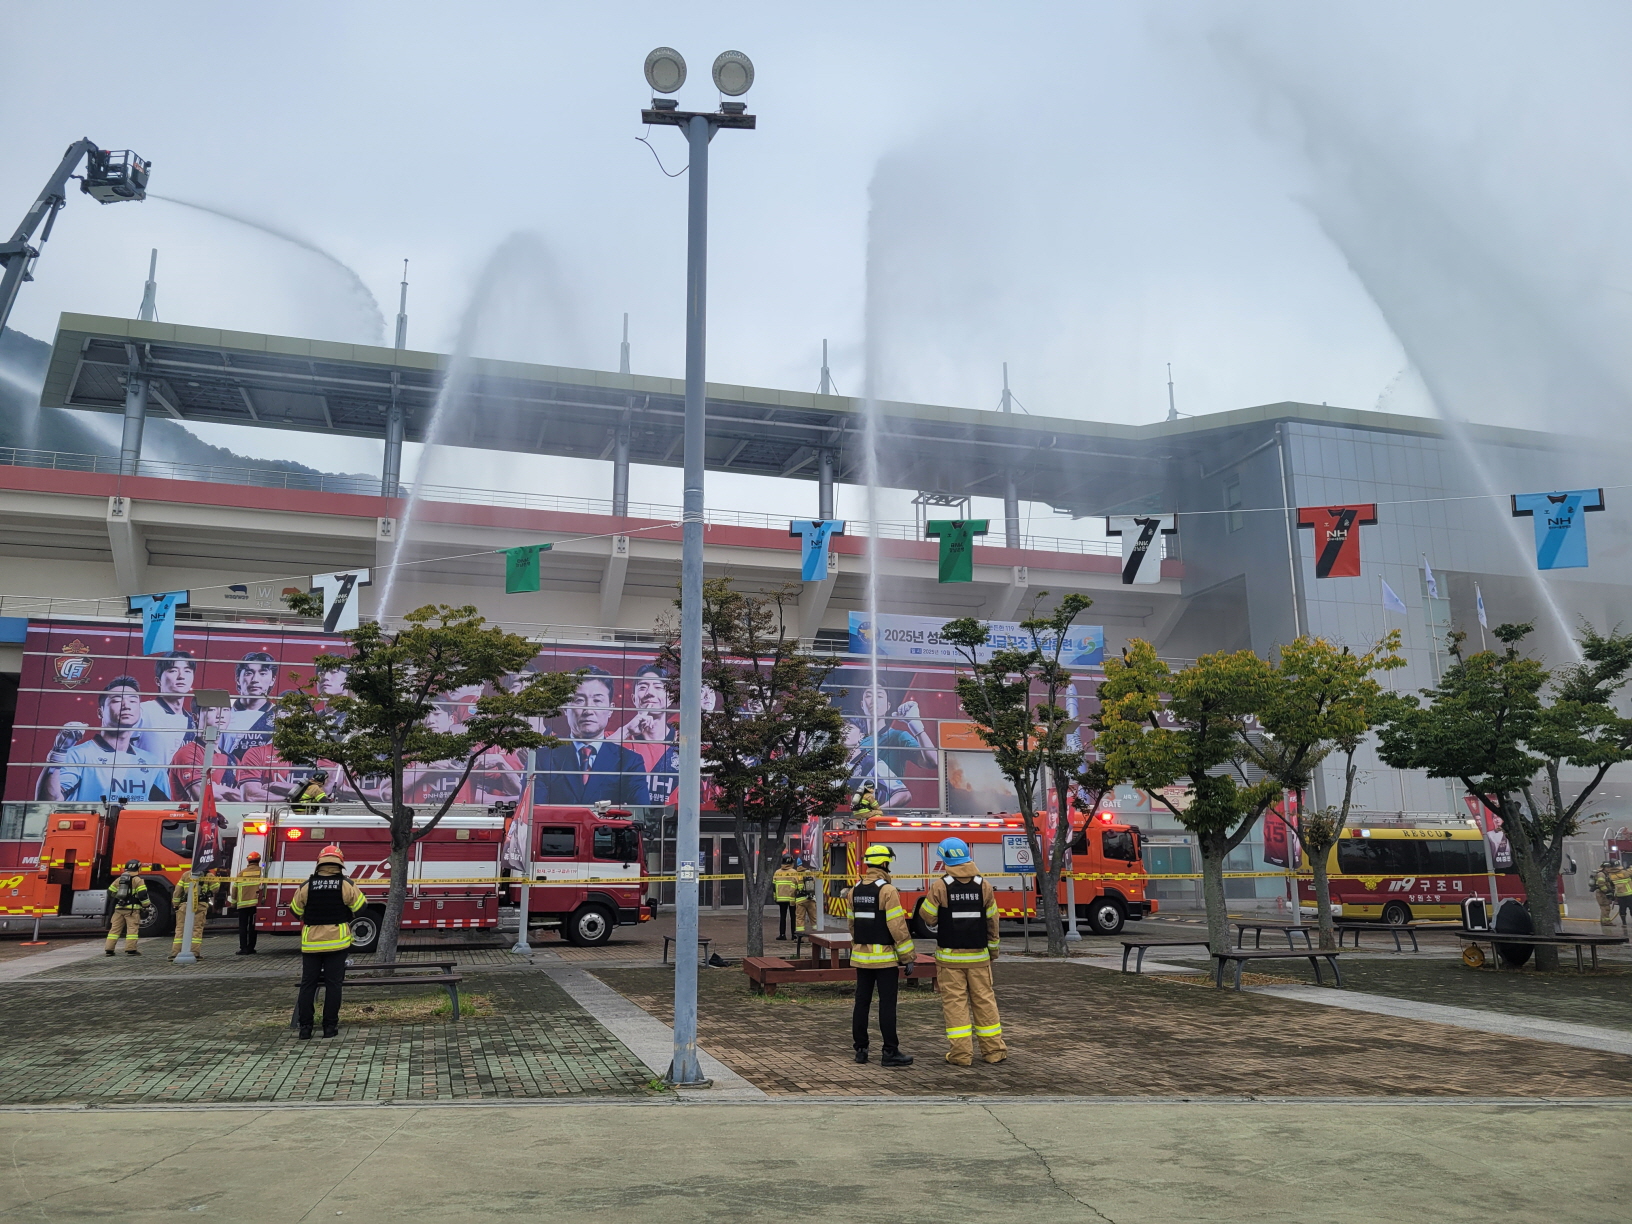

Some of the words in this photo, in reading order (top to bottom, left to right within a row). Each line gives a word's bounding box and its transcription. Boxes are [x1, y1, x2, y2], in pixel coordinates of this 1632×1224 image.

[1547, 517, 1571, 526] NH
[1326, 529, 1347, 538] NH
[150, 612, 166, 620] NH
[884, 628, 924, 644] 2025년
[110, 778, 146, 793] NH
[422, 777, 460, 792] NH
[1264, 825, 1286, 843] 15
[1403, 829, 1452, 838] RESCU
[1007, 837, 1031, 846] 금연구
[1387, 876, 1416, 892] 119
[1419, 879, 1463, 892] 구조대
[1408, 894, 1441, 902] 창원소방
